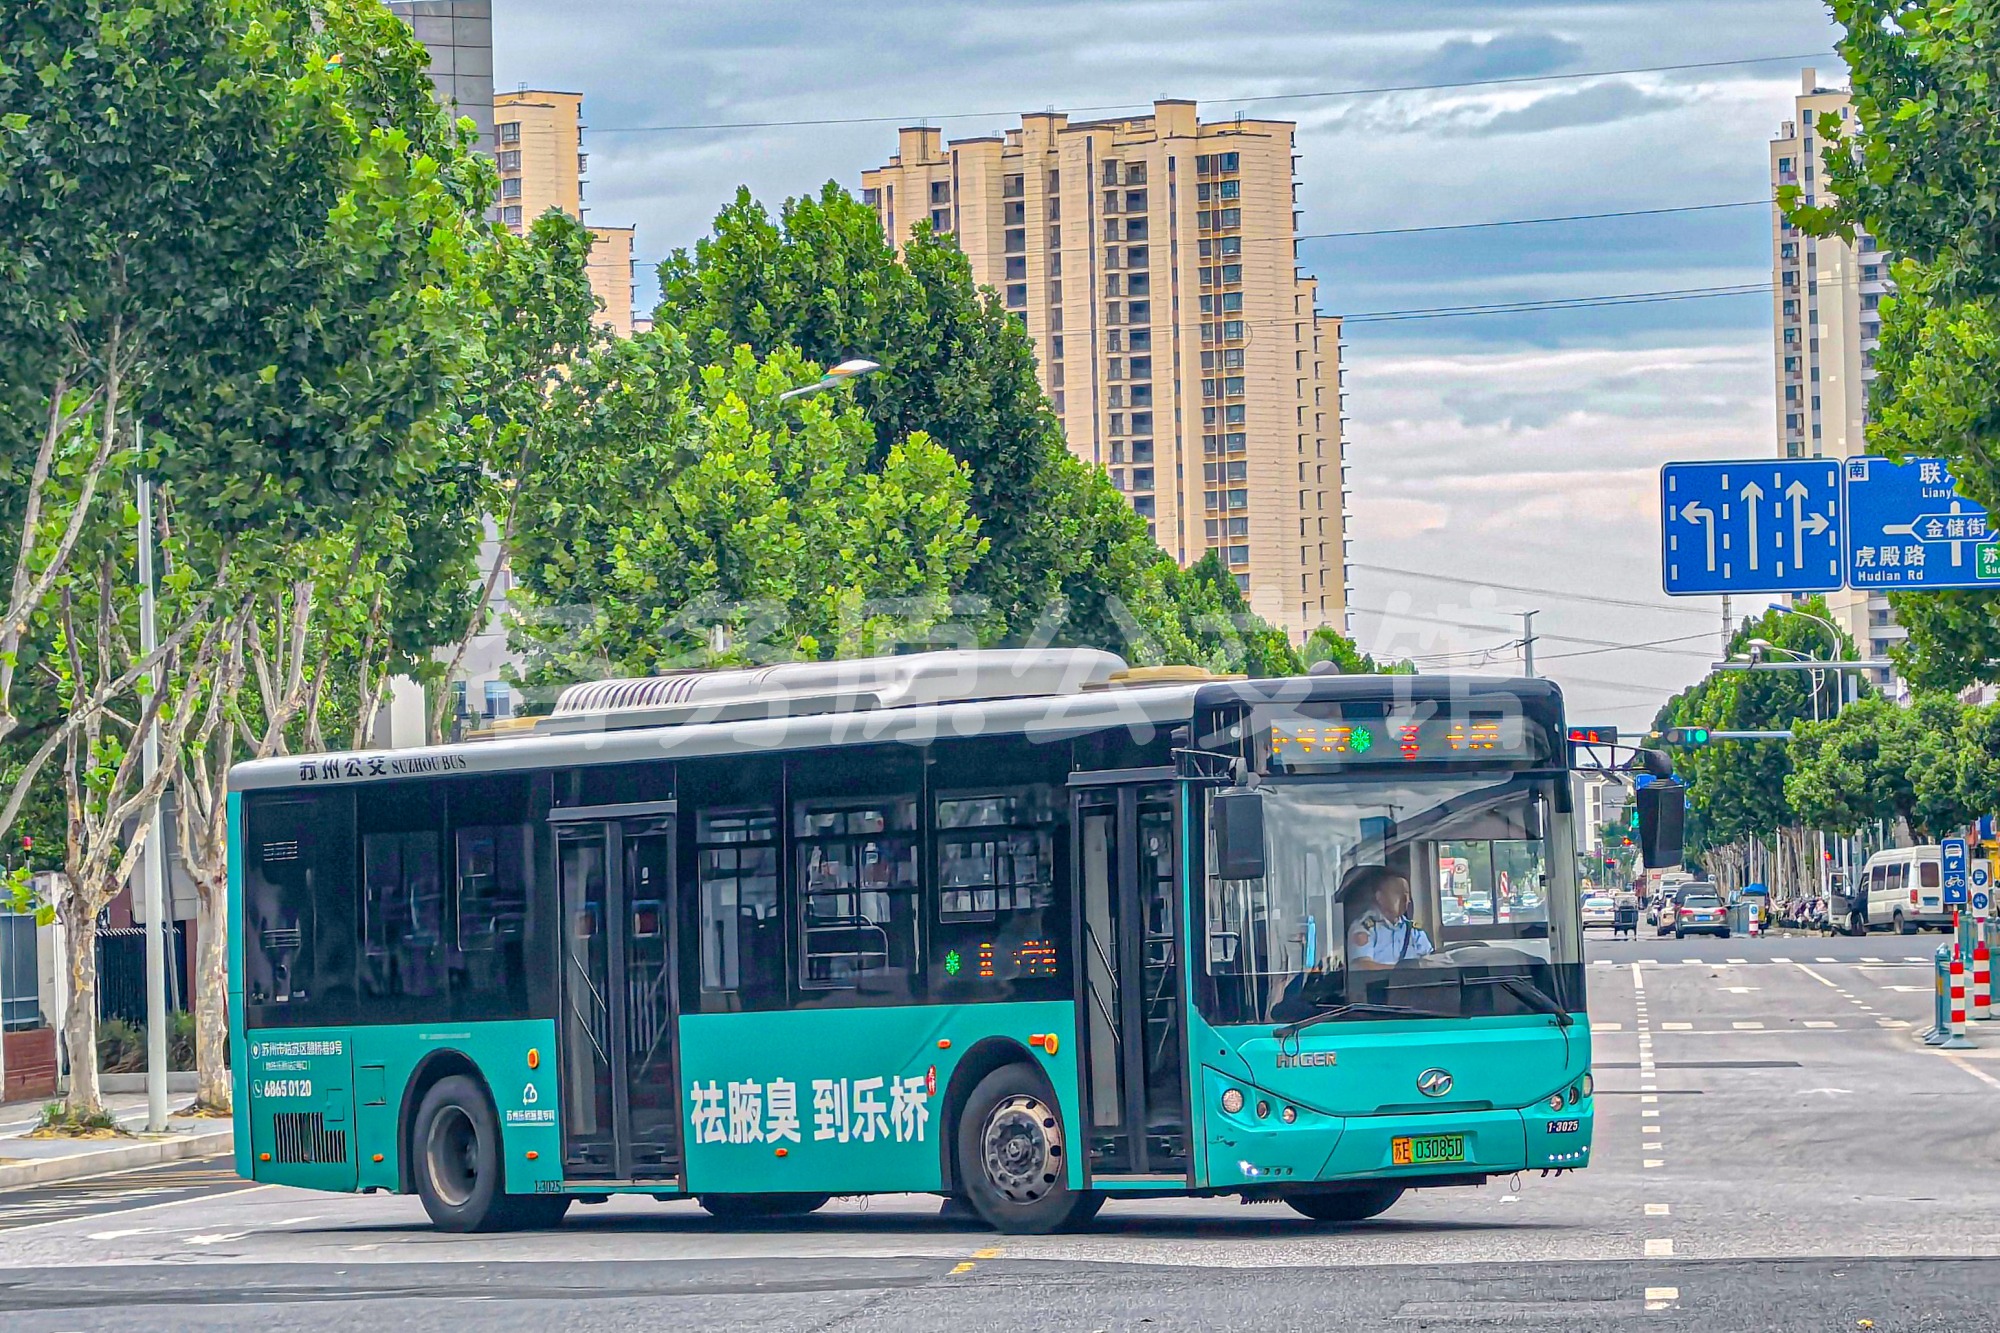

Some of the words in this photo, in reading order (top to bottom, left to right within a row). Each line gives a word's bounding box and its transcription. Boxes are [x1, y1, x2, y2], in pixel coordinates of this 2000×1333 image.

[1849, 461, 1866, 478] 南
[1925, 518, 1987, 538] 金储街
[1855, 545, 1926, 567] 虎殿路
[1858, 571, 1901, 582] Hudian
[1907, 570, 1924, 581] Rd
[300, 756, 387, 781] 苏州公交
[391, 756, 440, 774] SUZHOU
[443, 754, 466, 770] BUS
[288, 1080, 312, 1096] 0120
[691, 1077, 801, 1144] 祛腋臭
[811, 1075, 929, 1143] 到乐桥
[1548, 1120, 1579, 1133] 1-3025
[1415, 1138, 1463, 1159] 03085D
